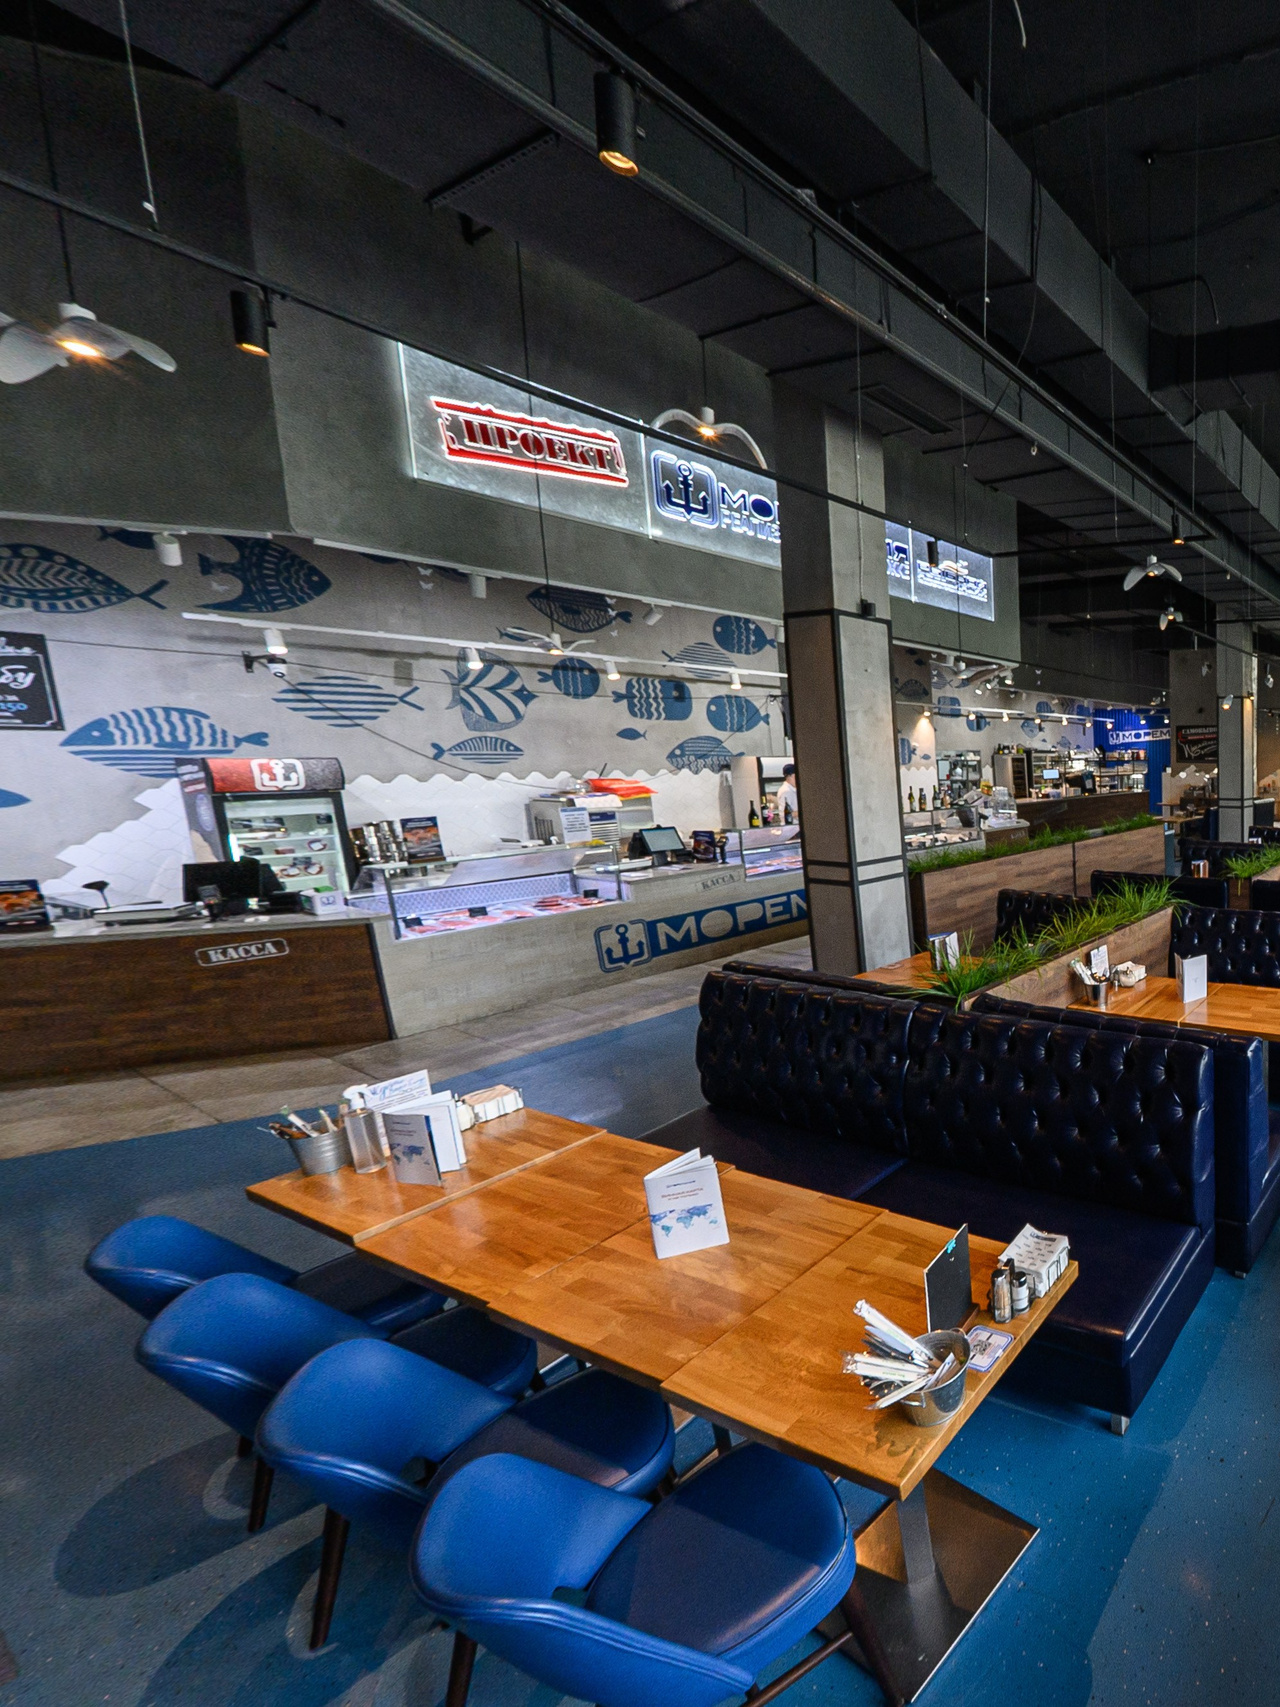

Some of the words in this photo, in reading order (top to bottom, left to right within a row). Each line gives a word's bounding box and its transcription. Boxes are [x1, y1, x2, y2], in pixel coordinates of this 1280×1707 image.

[458, 416, 612, 472] ПРОЕКТ
[718, 481, 780, 525] МО
[700, 873, 735, 890] КАССА
[207, 942, 278, 963] КАССА
